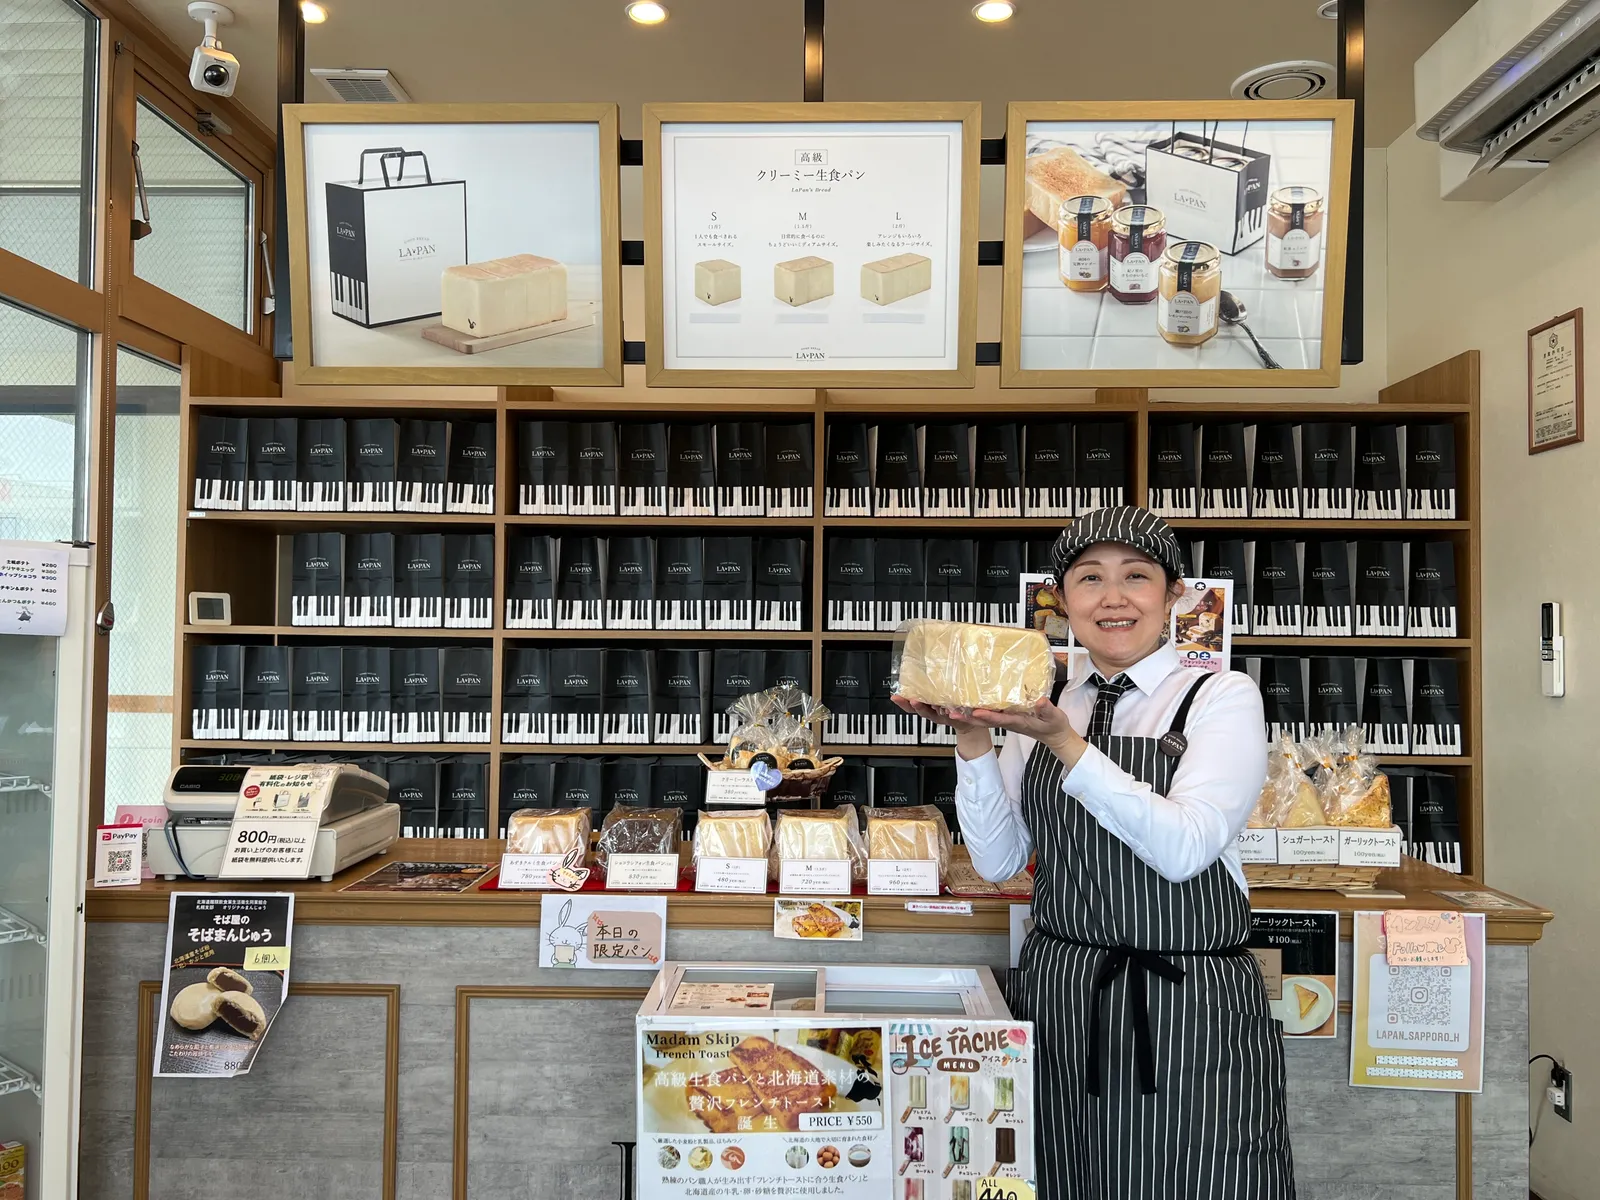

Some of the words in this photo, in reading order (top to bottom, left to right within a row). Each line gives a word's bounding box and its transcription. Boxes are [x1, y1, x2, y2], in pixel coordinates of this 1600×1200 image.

[800, 152, 822, 162] 高級
[757, 168, 866, 181] クリーミー生食パン
[711, 212, 717, 221] S
[798, 212, 807, 220] M
[896, 212, 901, 220] L
[1283, 836, 1335, 844] シュガートースト
[1344, 838, 1396, 846] ガーリックトースト
[213, 915, 250, 925] そば屋の
[1252, 918, 1317, 927] ガーリックトースト
[188, 928, 272, 942] そばまんじゅう
[597, 924, 638, 940] 本日の
[594, 944, 652, 960] 限定パン
[254, 954, 279, 963] 6個入
[646, 1033, 700, 1046] Madam
[705, 1033, 740, 1047] Skip
[656, 1050, 695, 1059] French
[699, 1050, 730, 1059] Toast
[901, 1035, 943, 1067] ICE
[654, 1070, 870, 1088] 高級生食パンと北海道素材の
[689, 1095, 836, 1112] 贅沢フレンチトースト
[809, 1116, 842, 1127] PRICE
[847, 1116, 873, 1126] ¥550
[981, 1179, 997, 1187] ALL
